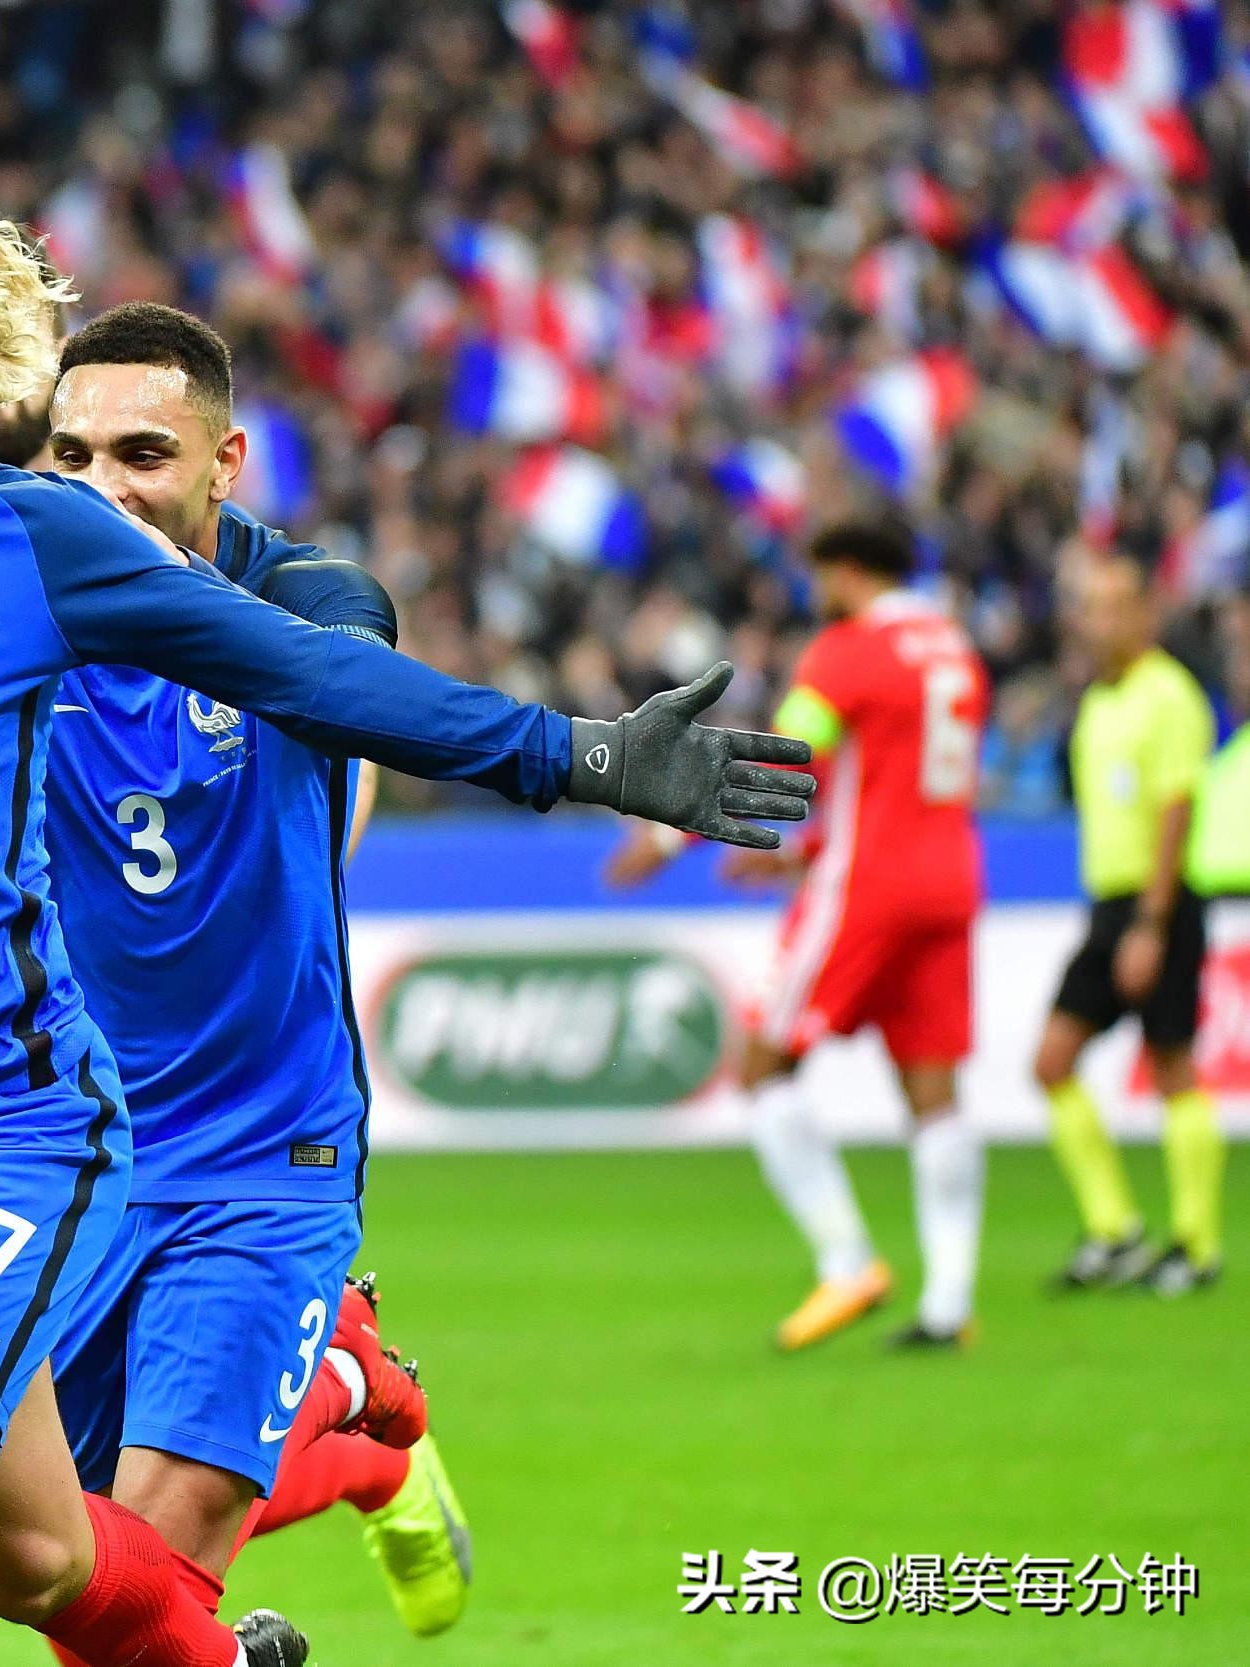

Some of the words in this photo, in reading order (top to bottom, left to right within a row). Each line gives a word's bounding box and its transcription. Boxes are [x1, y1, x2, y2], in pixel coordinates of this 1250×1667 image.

[116, 794, 177, 895] 3
[393, 972, 622, 1082] PMU
[279, 1298, 327, 1410] 3
